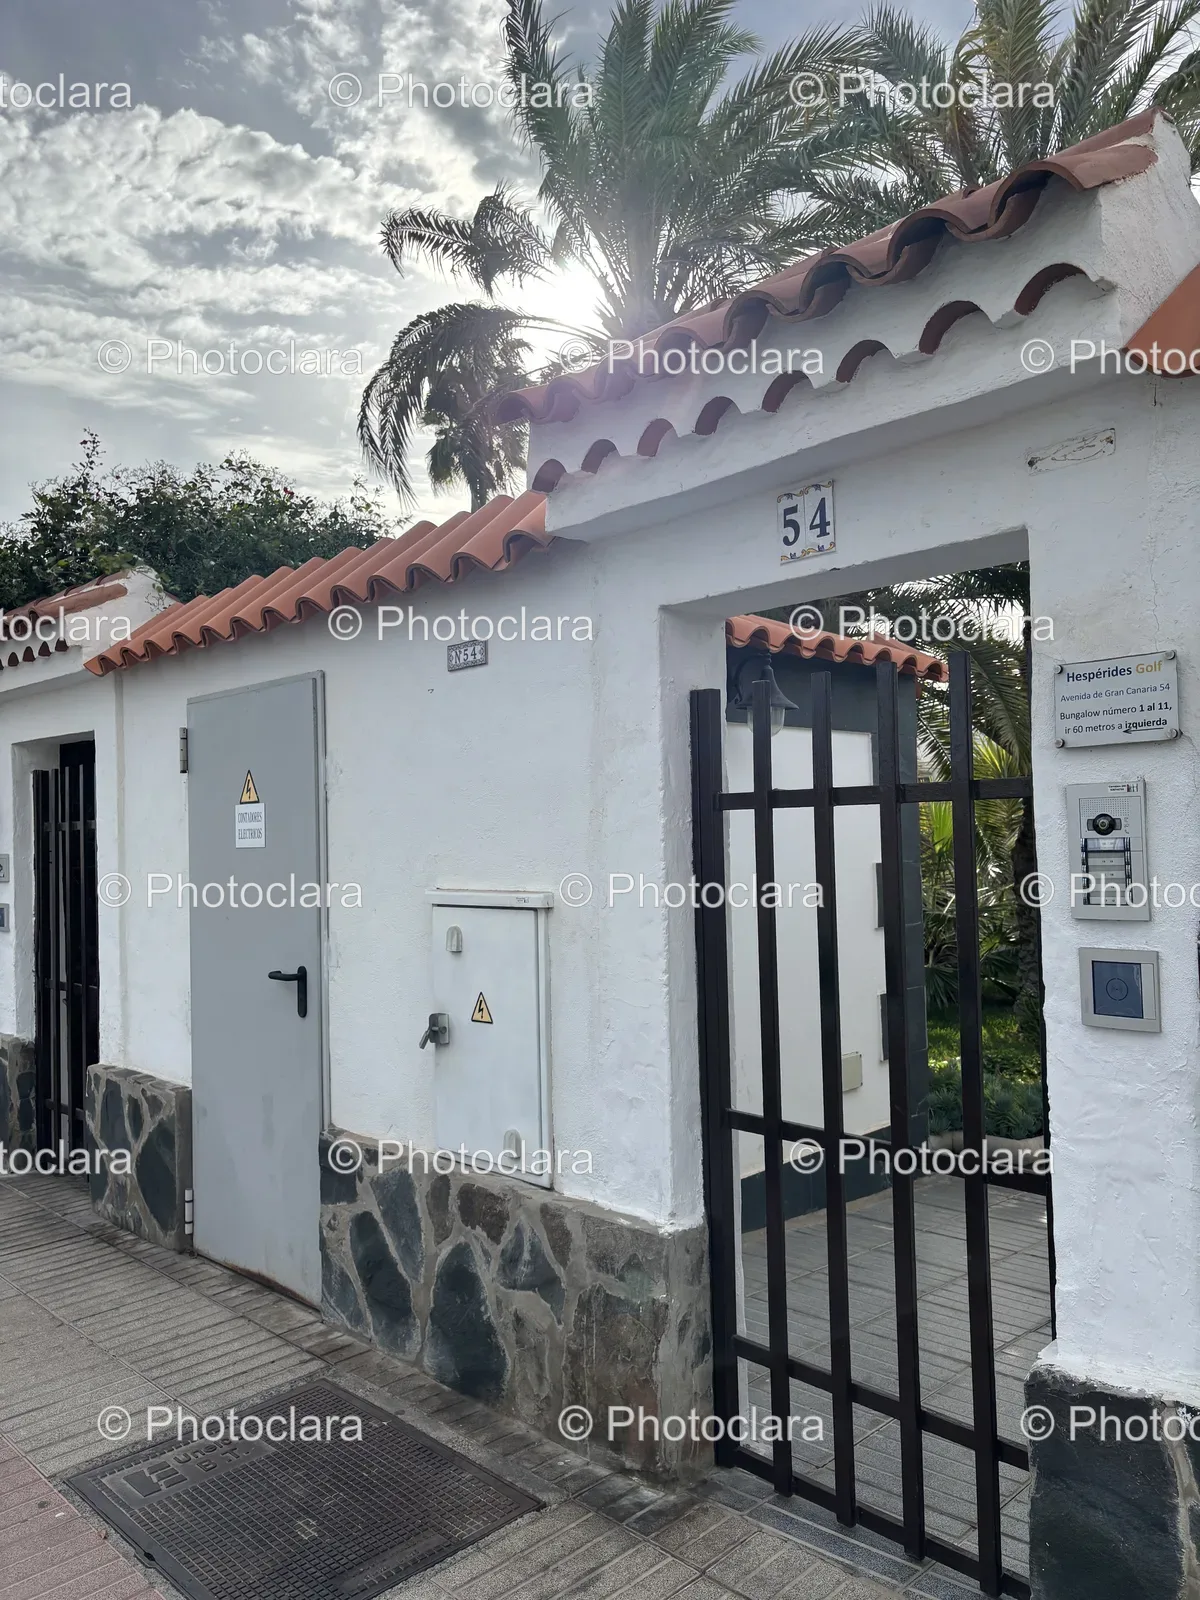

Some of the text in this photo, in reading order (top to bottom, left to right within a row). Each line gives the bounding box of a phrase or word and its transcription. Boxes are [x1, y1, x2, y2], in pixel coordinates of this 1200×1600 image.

[782, 497, 831, 546] 54
[1067, 660, 1162, 682] Hespérides Golf
[1060, 683, 1170, 702] Avenida de Gran Canaria 54
[1060, 702, 1172, 720] Bungalow número 1 al 11,
[1064, 726, 1071, 734] ir
[1072, 725, 1083, 734] 60
[1085, 723, 1115, 733] metros
[1125, 718, 1168, 730] izquierda
[237, 811, 263, 823] CONTADORES
